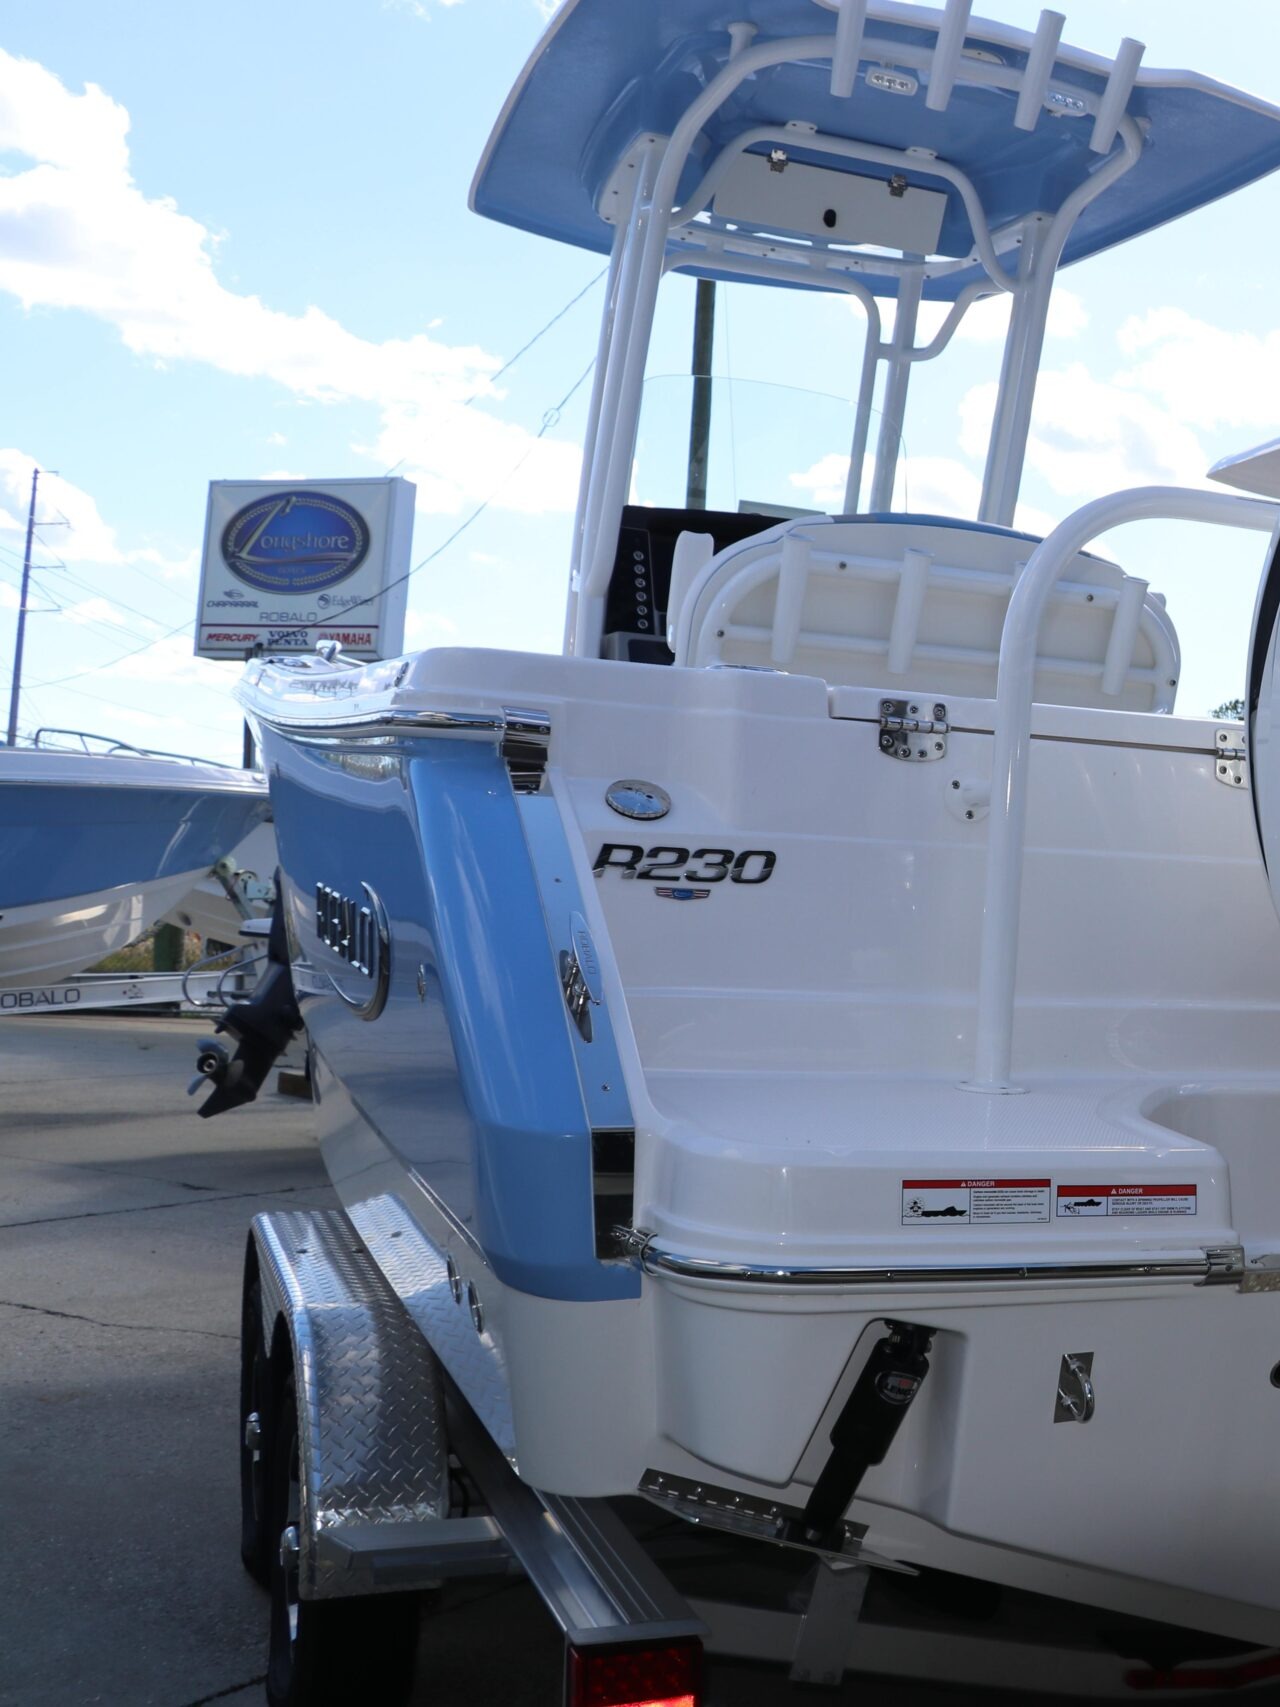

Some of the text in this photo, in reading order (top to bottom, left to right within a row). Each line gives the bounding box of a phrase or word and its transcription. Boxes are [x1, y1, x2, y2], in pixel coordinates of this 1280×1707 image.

[230, 496, 353, 560] Longshore
[259, 611, 318, 623] ROBALO
[206, 632, 260, 643] MERCURY
[268, 630, 309, 638] VOLVO
[329, 633, 372, 646] YAMAHA
[267, 637, 309, 646] PENTA
[592, 843, 777, 884] R230
[0, 988, 81, 1009] OBALO
[967, 1180, 996, 1188] DANGER
